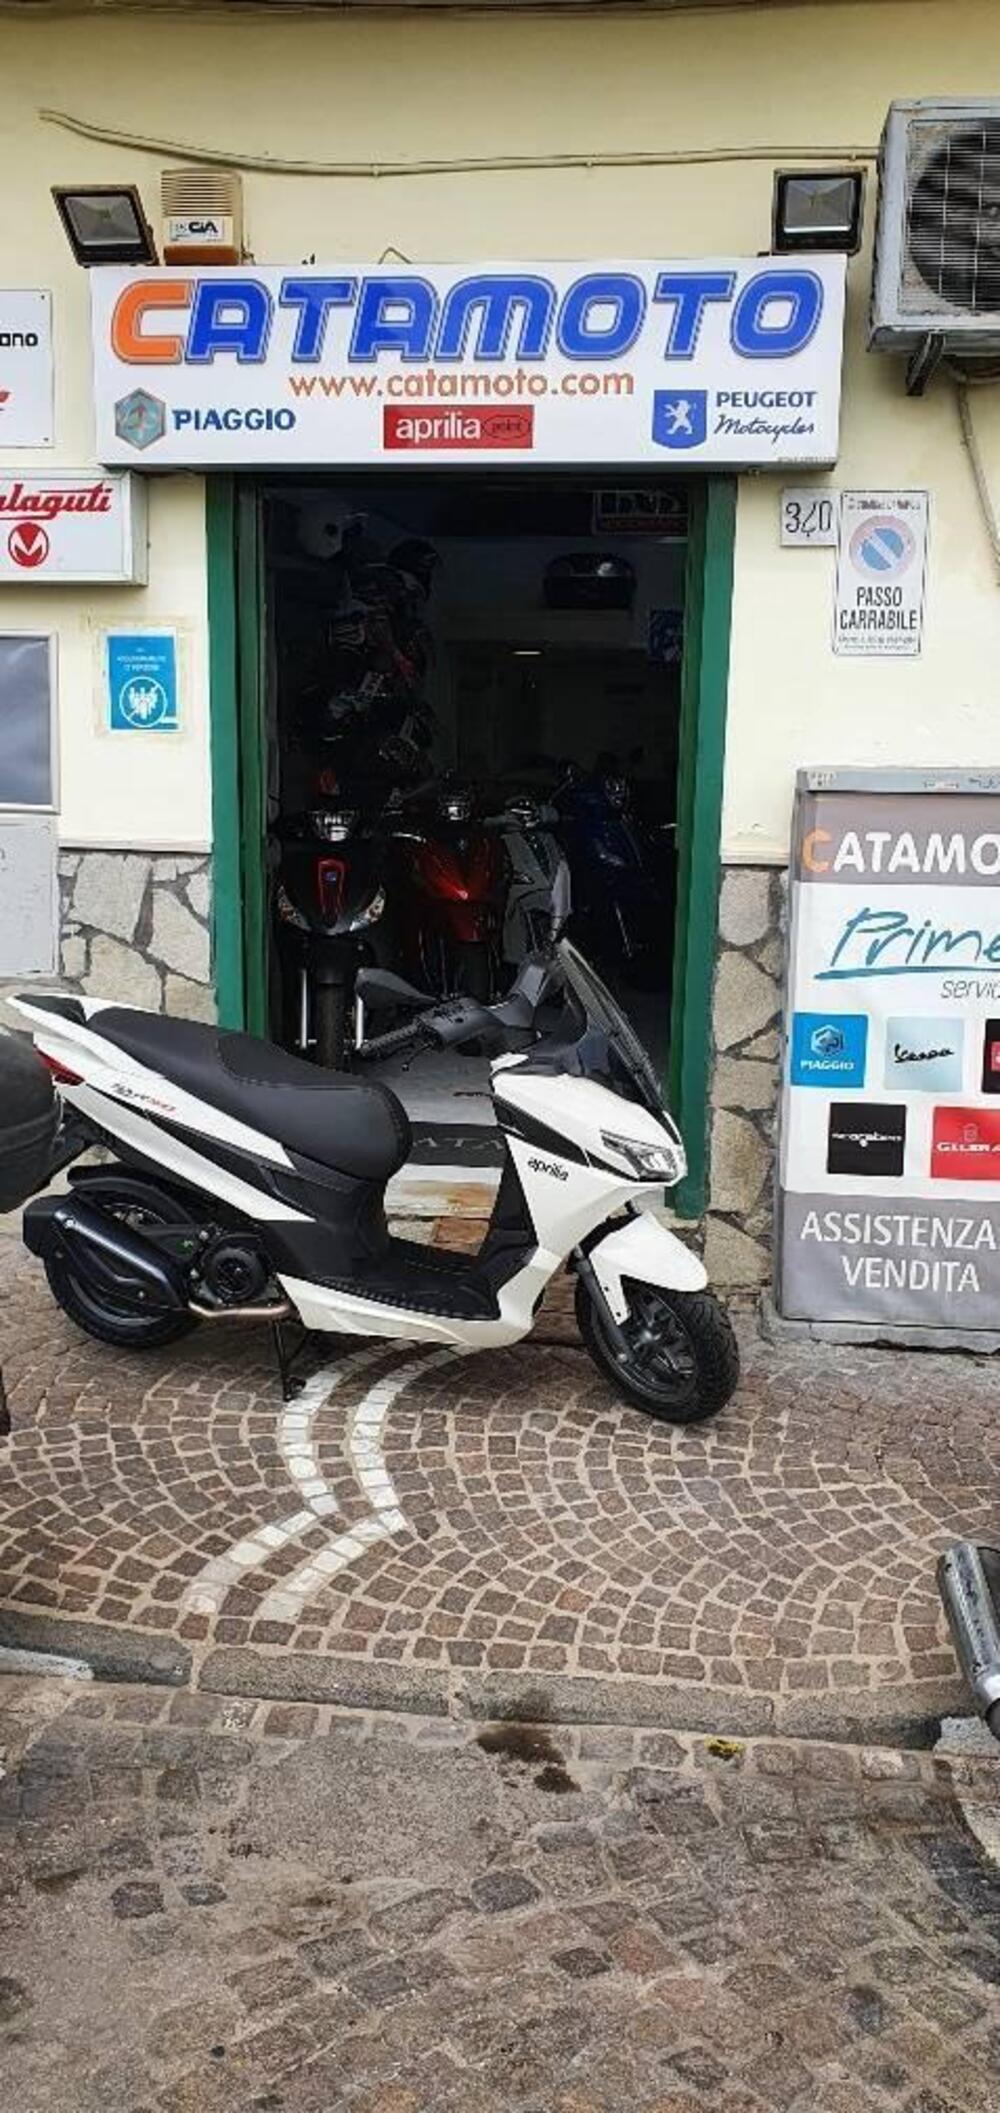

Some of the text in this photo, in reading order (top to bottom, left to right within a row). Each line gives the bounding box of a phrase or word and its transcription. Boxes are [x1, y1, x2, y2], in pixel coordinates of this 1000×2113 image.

[110, 269, 825, 366] CATAMOTO
[288, 368, 635, 398] www.catamoto.com
[716, 391, 817, 408] PEUGEOT
[171, 408, 297, 431] PIAGGIO
[395, 412, 482, 442] aprilia
[712, 413, 815, 444] Motocycles
[856, 586, 903, 607] PASSO
[840, 609, 918, 631] CARRABILE
[802, 829, 1000, 876] CATAMO
[800, 1059, 855, 1071] PIAGGIO
[527, 1155, 570, 1182] aprilia
[800, 1210, 997, 1250] ASSISTENZA
[841, 1255, 981, 1293] VENDITA
